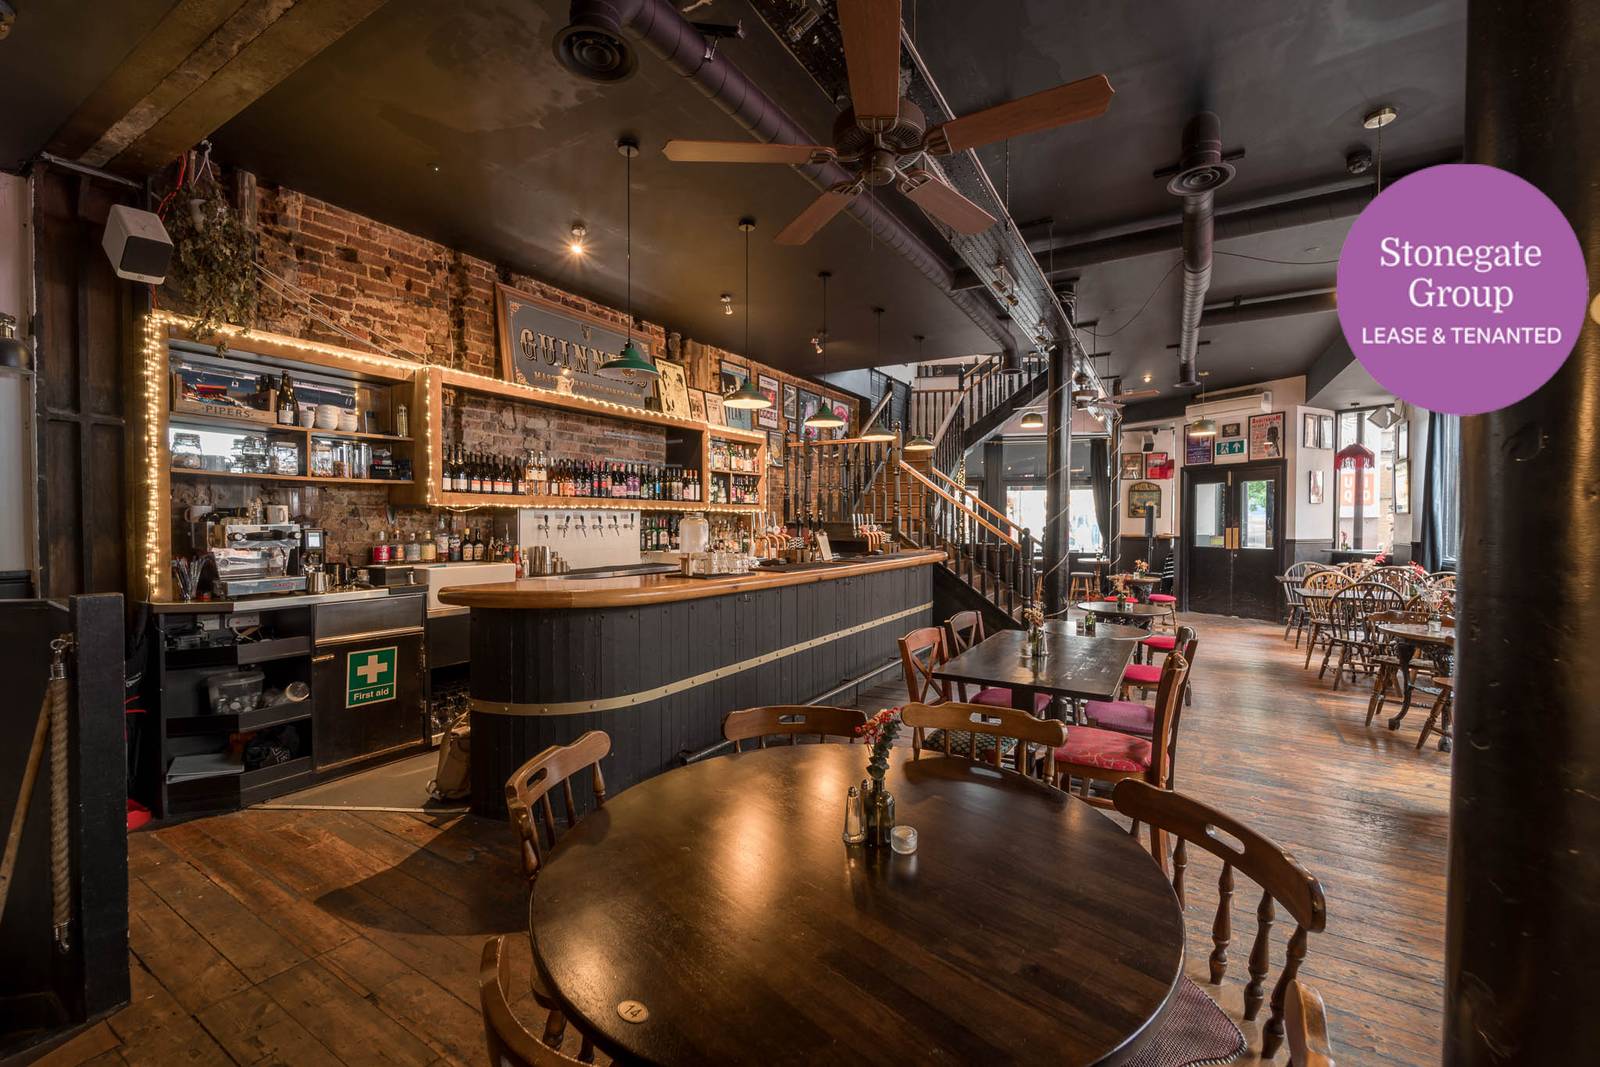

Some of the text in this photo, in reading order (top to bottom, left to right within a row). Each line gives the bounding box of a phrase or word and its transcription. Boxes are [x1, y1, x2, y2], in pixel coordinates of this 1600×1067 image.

[520, 328, 648, 389] GUINN
[206, 403, 250, 418] PIPERS
[353, 687, 389, 701] First aid
